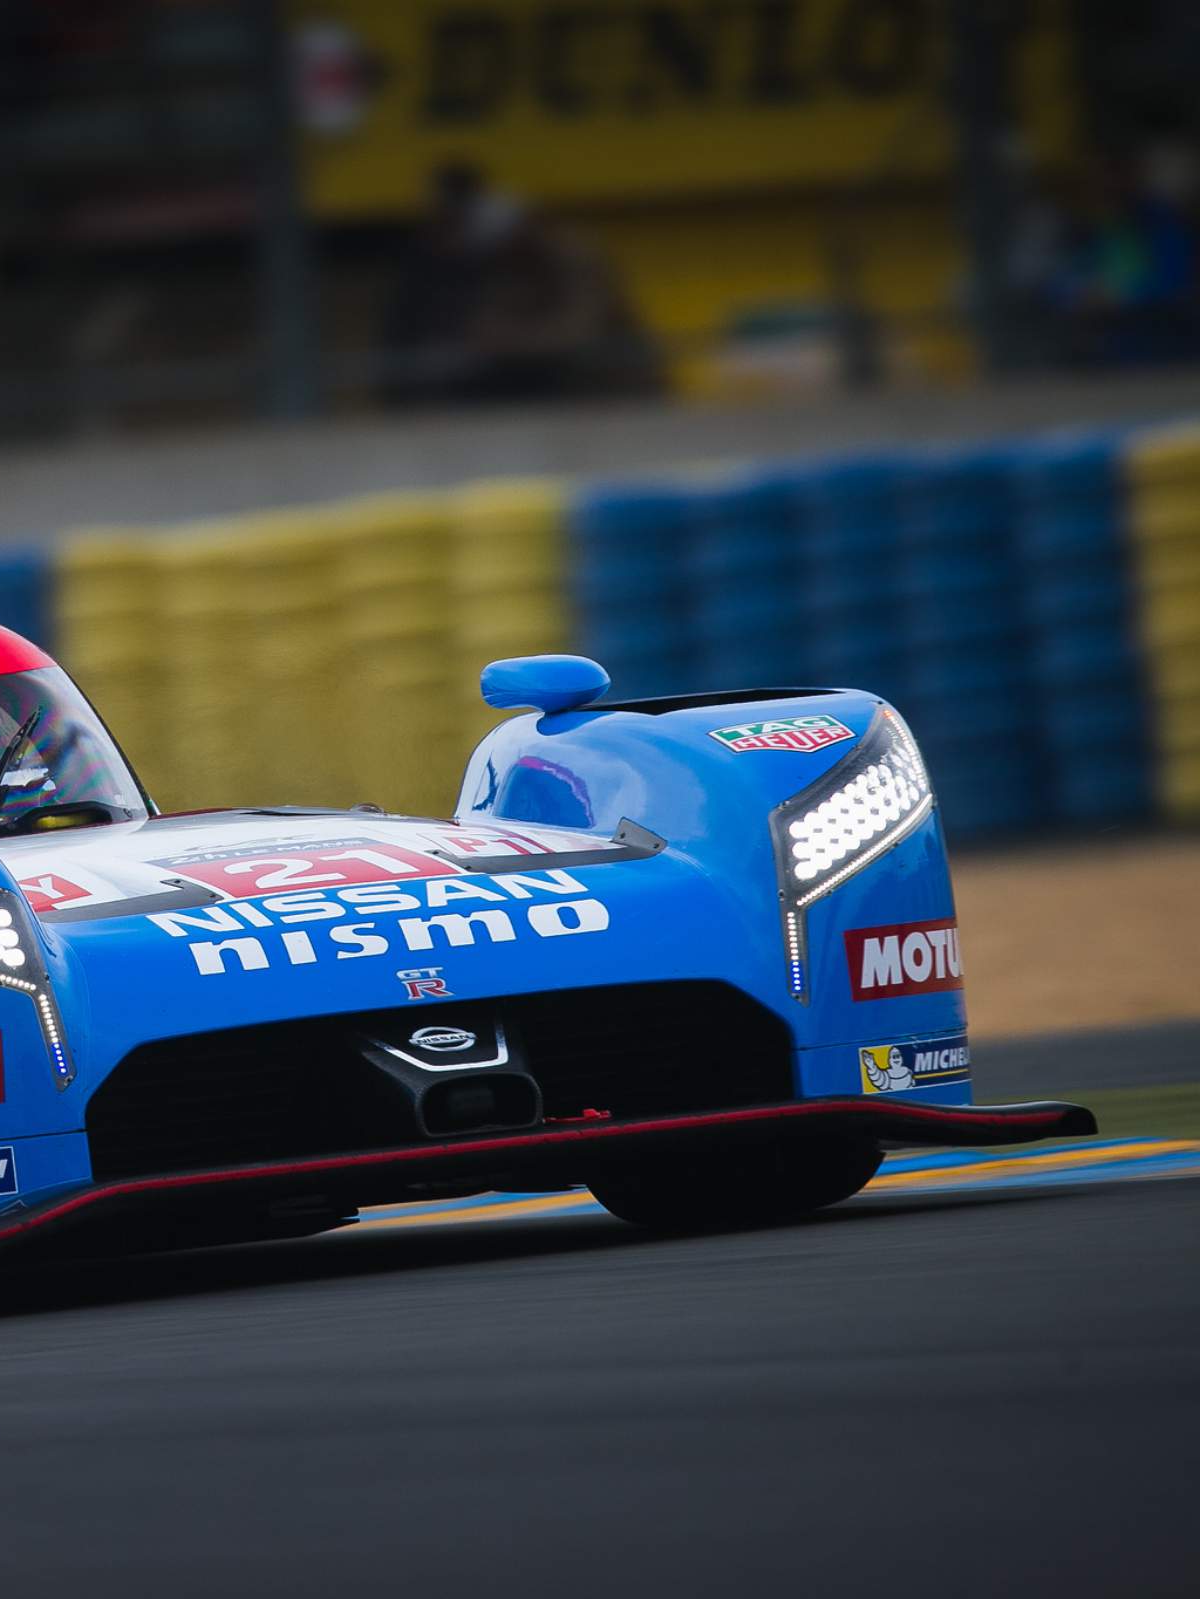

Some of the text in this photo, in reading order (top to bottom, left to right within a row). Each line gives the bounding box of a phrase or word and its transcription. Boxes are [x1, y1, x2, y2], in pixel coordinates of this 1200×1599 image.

[418, 0, 925, 124] DUNLO
[721, 716, 832, 738] TAG
[734, 726, 848, 750] HEUER
[448, 837, 533, 856] P1
[224, 850, 419, 889] 21
[145, 869, 588, 937] NISSAN
[189, 899, 610, 975] nismo
[861, 928, 965, 989] MOTU
[396, 966, 443, 980] GT
[401, 978, 455, 1000] R
[416, 1033, 472, 1045] NISSAN
[914, 1047, 969, 1073] MICHE
